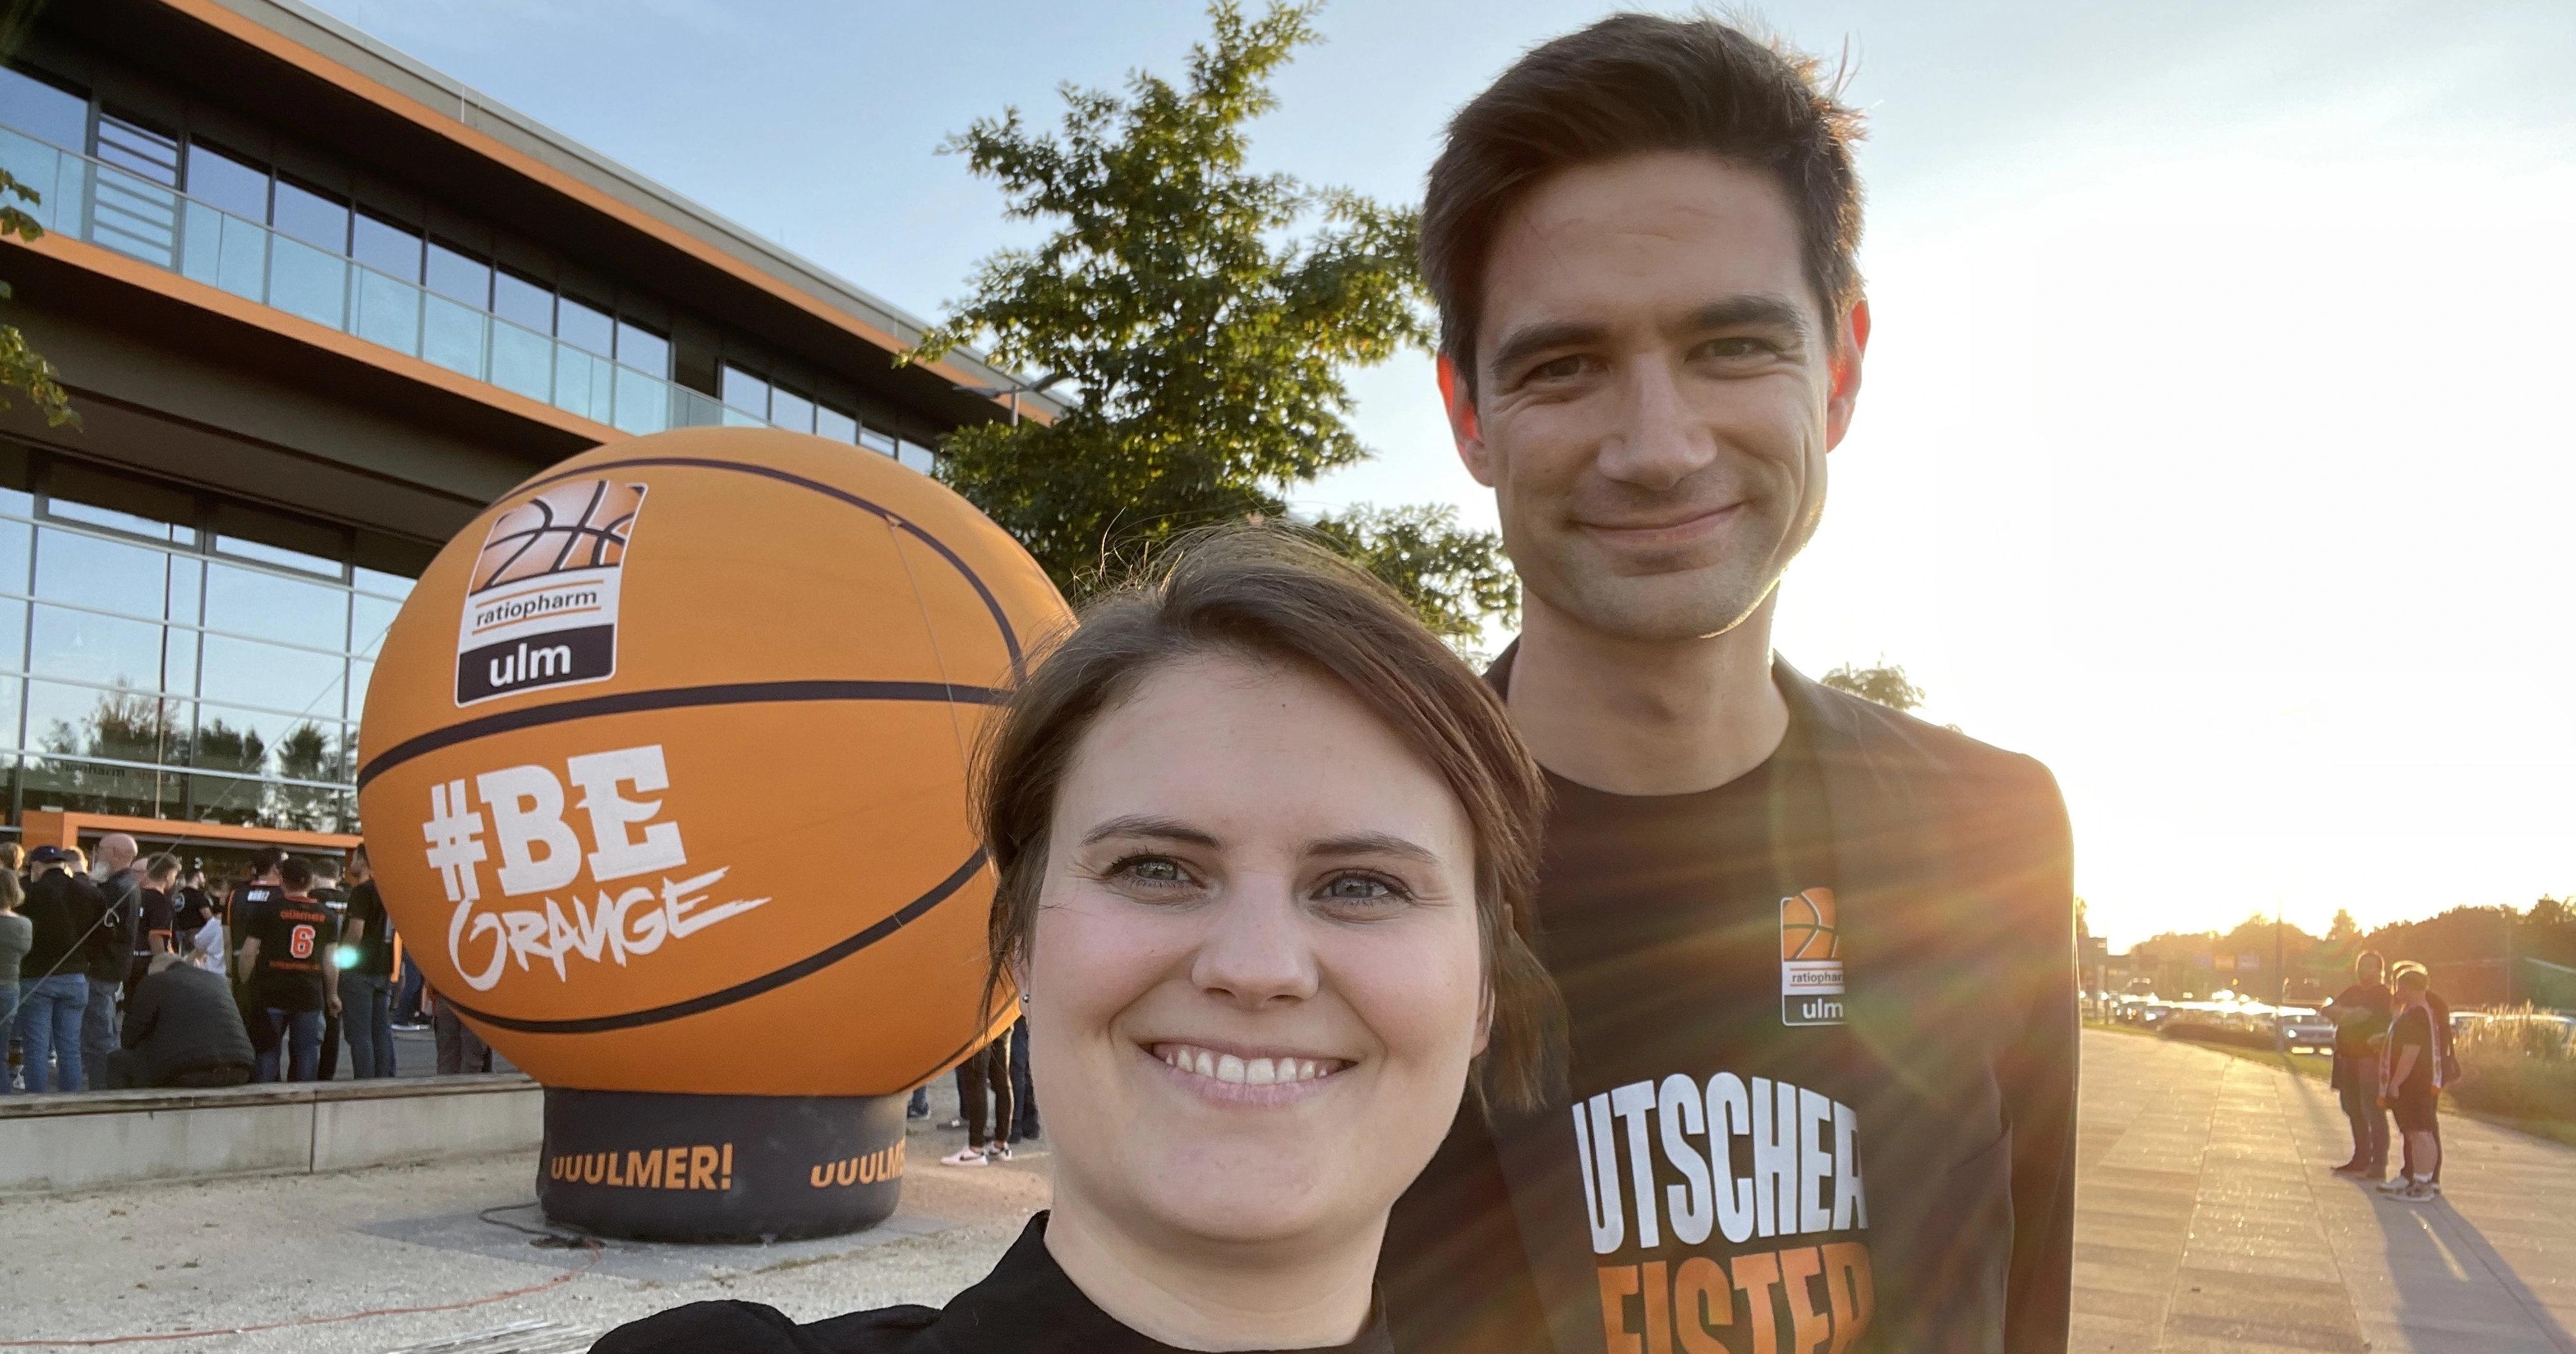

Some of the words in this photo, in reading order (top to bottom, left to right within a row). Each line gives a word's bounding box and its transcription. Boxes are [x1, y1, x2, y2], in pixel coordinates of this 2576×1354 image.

[476, 591, 597, 627] ratiopharm
[489, 642, 571, 687] ulm
[423, 744, 687, 902] #BE
[290, 924, 316, 959] 6
[448, 865, 772, 991] ORANGE
[1791, 971, 1844, 984] ratiophar
[1803, 998, 1844, 1019] ulm
[550, 1142, 733, 1191] UUULMER!
